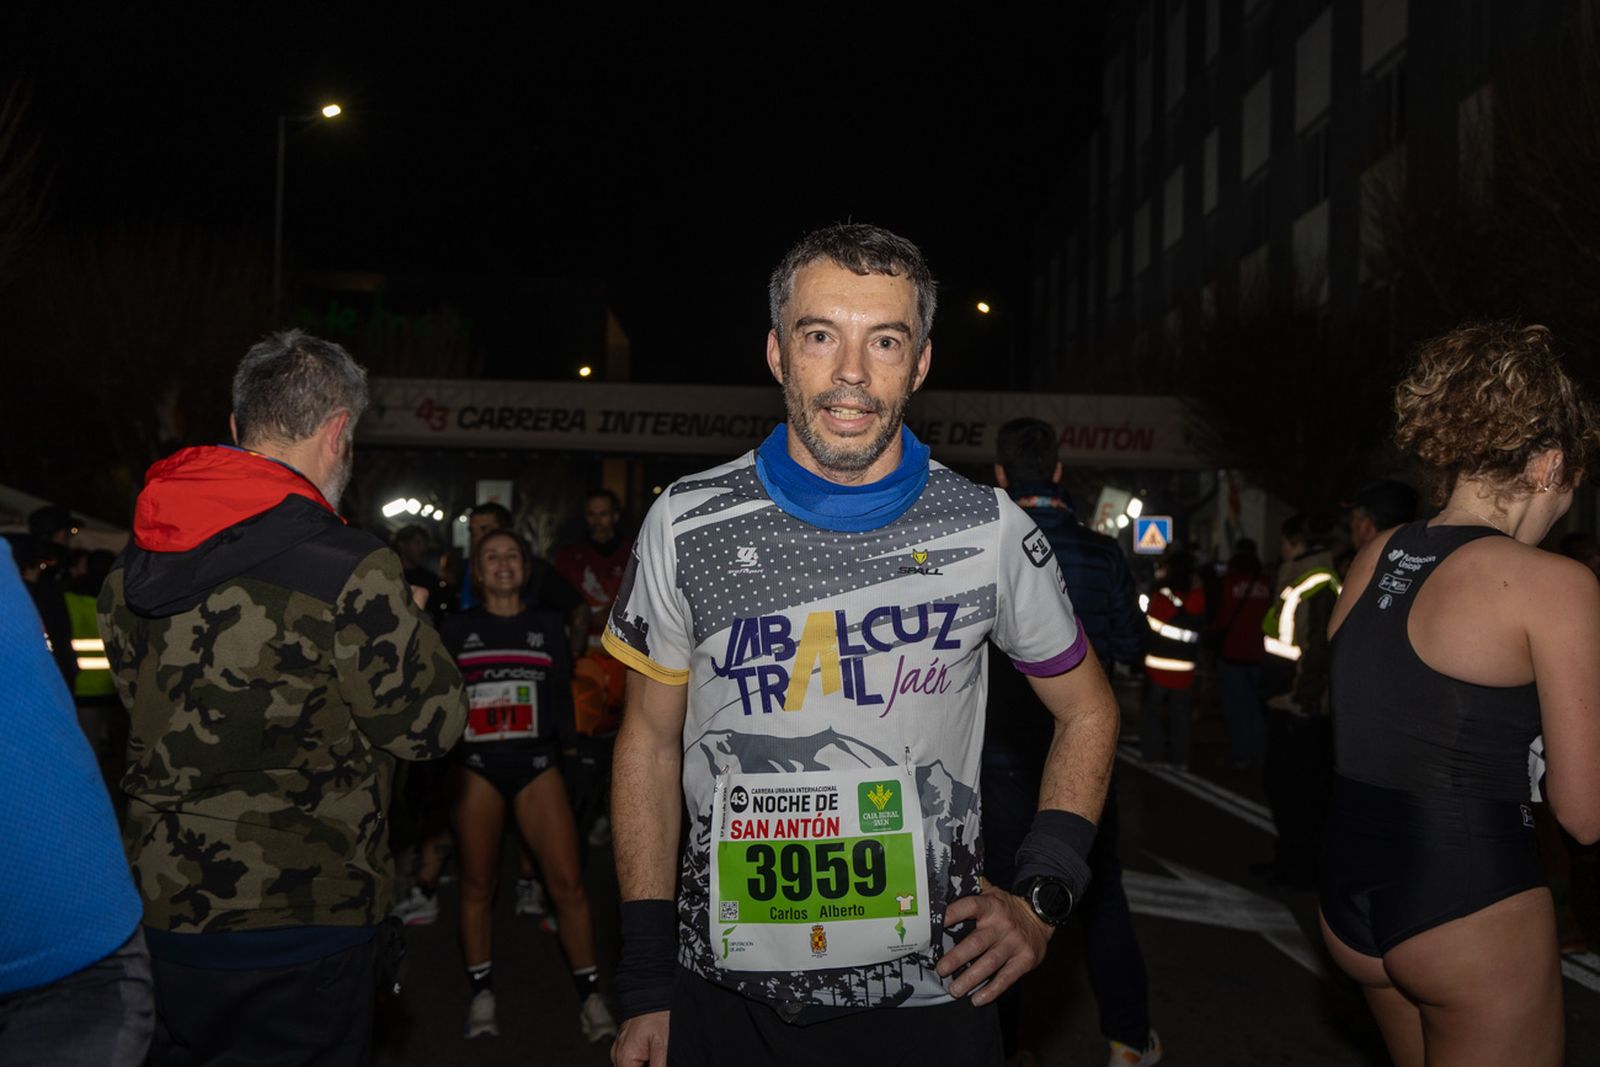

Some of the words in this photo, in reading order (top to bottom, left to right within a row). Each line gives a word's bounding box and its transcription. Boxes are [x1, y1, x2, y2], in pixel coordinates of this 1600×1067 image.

[416, 400, 449, 432] 43
[457, 406, 587, 432] CARRERA
[947, 421, 986, 446] DE
[1058, 420, 1155, 453] ANTÓN
[897, 566, 944, 576] SPALL
[711, 603, 962, 678] JABALCUZ
[728, 656, 885, 716] TRAIL
[879, 654, 952, 718] Jaén
[730, 791, 749, 806] 43
[796, 785, 837, 793] INTERNACIONAL
[753, 794, 811, 813] NOCHE
[815, 793, 839, 812] DE
[730, 819, 769, 839] SAN
[773, 812, 840, 838] ANTÓN
[746, 839, 886, 901] 3959
[770, 906, 808, 920] Carlos
[819, 904, 865, 919] Alberto
